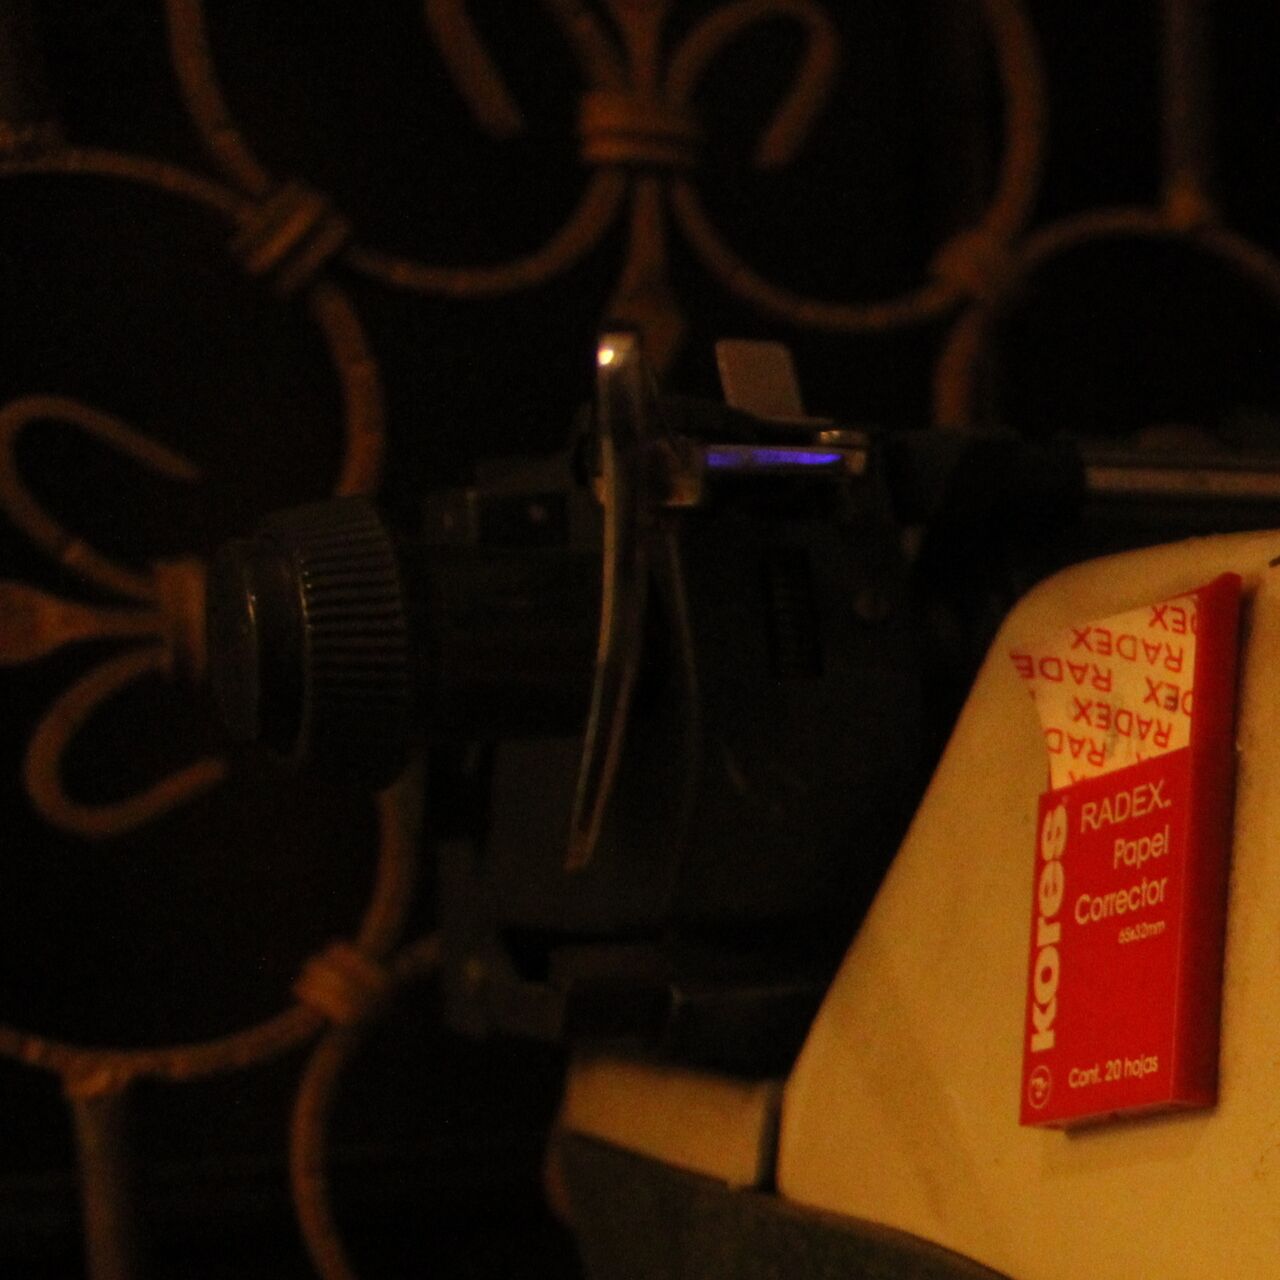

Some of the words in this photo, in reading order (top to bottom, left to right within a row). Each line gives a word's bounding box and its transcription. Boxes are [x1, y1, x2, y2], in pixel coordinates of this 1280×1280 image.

[1071, 627, 1183, 673] RADEX
[1072, 697, 1173, 748] RADEX
[1113, 824, 1170, 870] Papel
[1074, 876, 1168, 926] Corrector
[1104, 1057, 1122, 1083] 20
[1124, 1053, 1160, 1079] hojas
